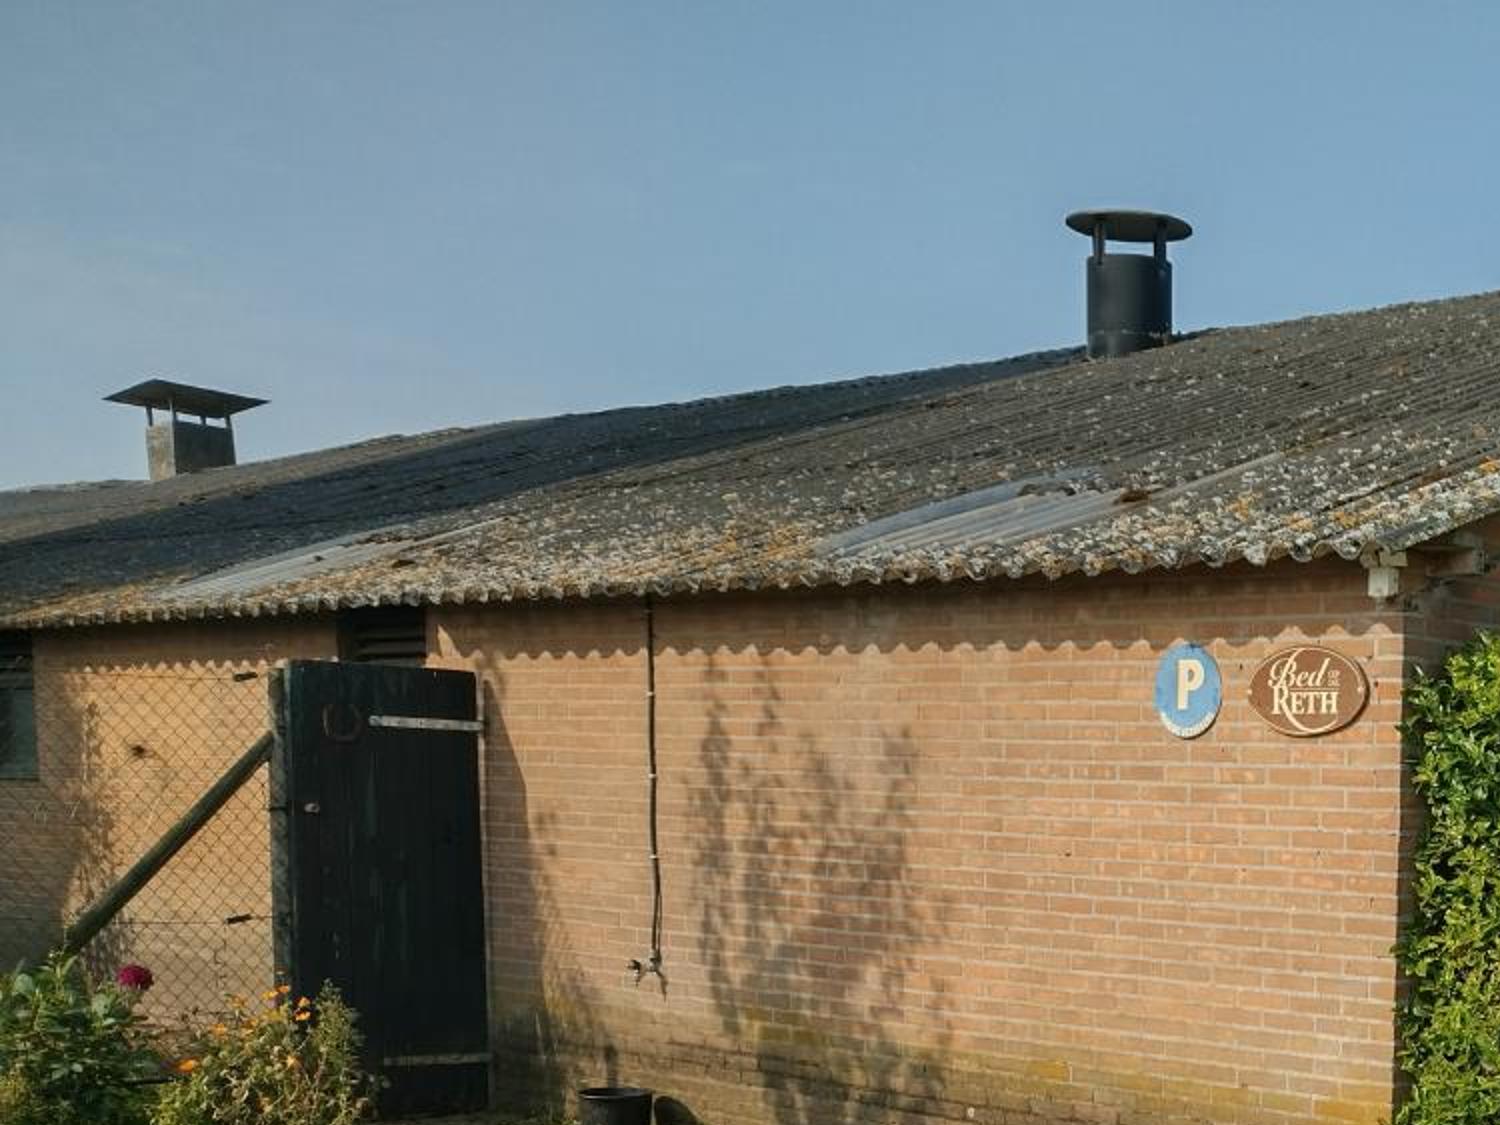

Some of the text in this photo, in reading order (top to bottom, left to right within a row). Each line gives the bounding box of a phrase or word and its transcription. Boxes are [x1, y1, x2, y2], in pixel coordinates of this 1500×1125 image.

[1177, 659, 1204, 710] P
[1267, 650, 1330, 687] Bed
[1271, 685, 1339, 718] RETH
